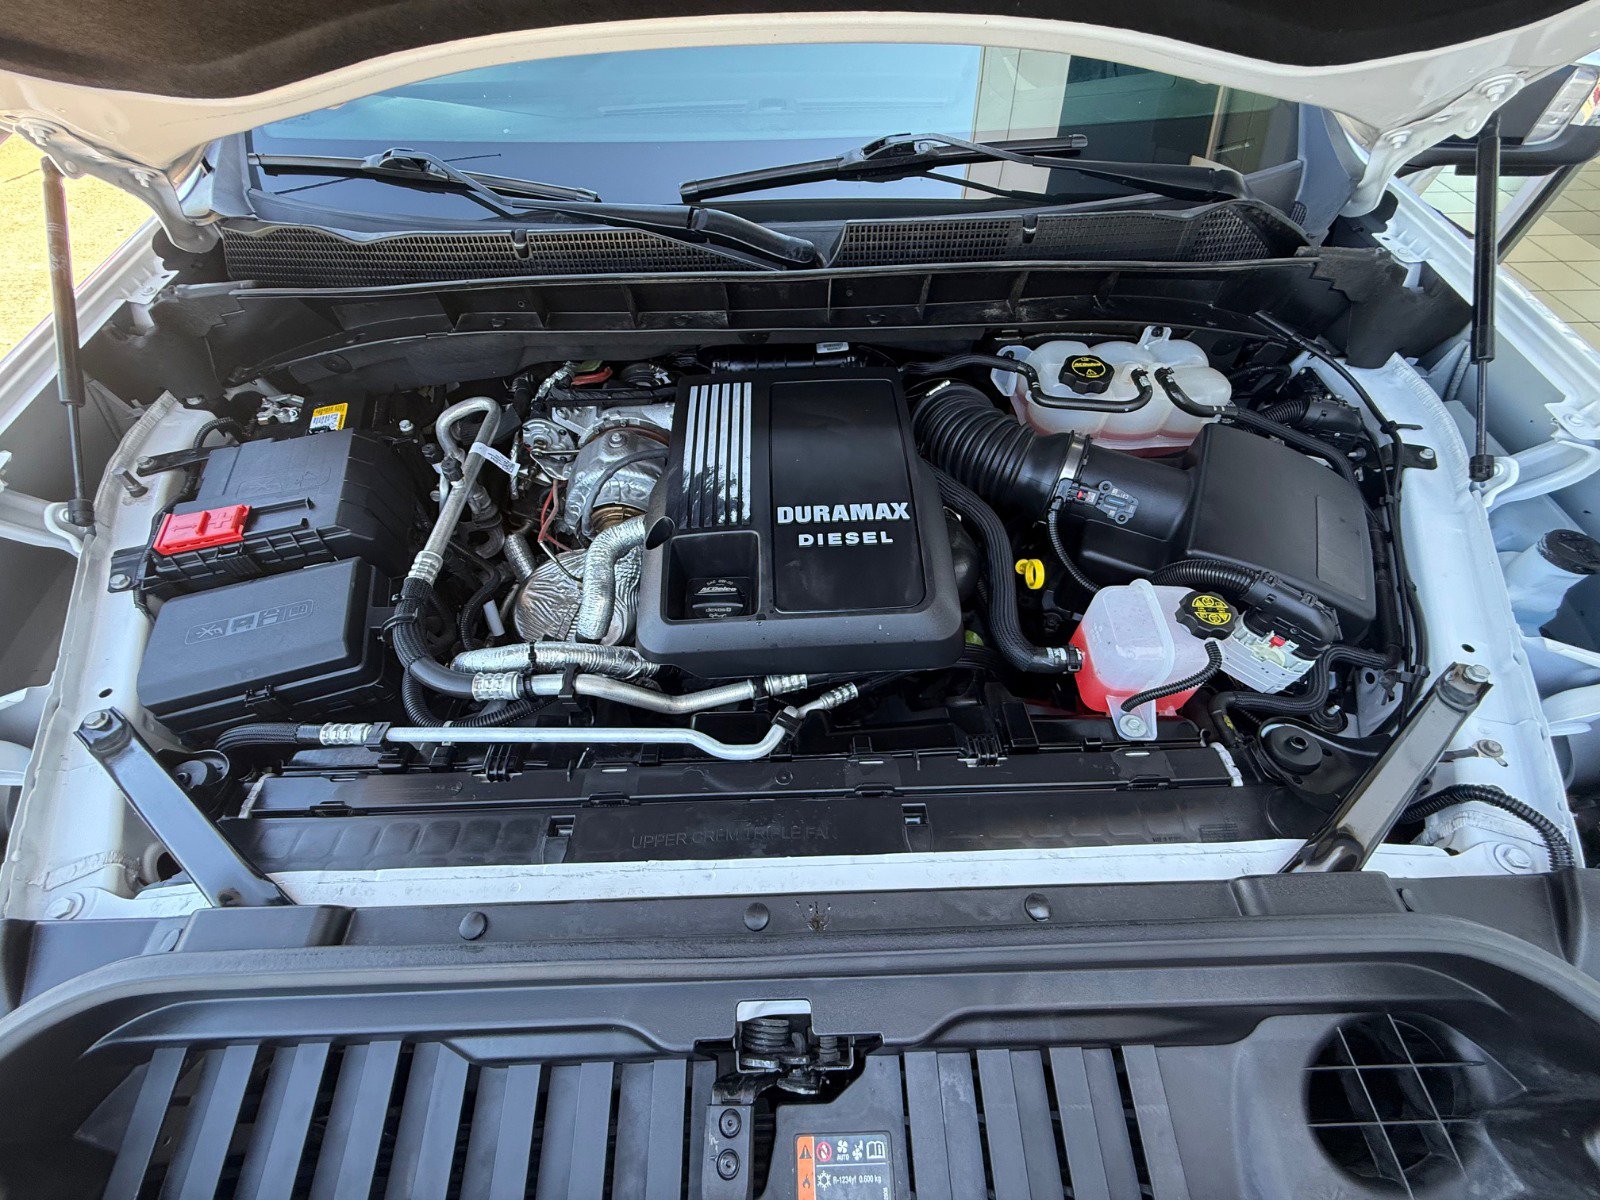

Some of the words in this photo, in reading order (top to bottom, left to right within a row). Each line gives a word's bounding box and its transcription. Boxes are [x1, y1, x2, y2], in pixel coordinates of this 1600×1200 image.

[777, 502, 910, 524] DURAMAX
[798, 531, 893, 547] DIESEL
[631, 831, 688, 849] UPPER
[836, 1153, 850, 1161] AUTO
